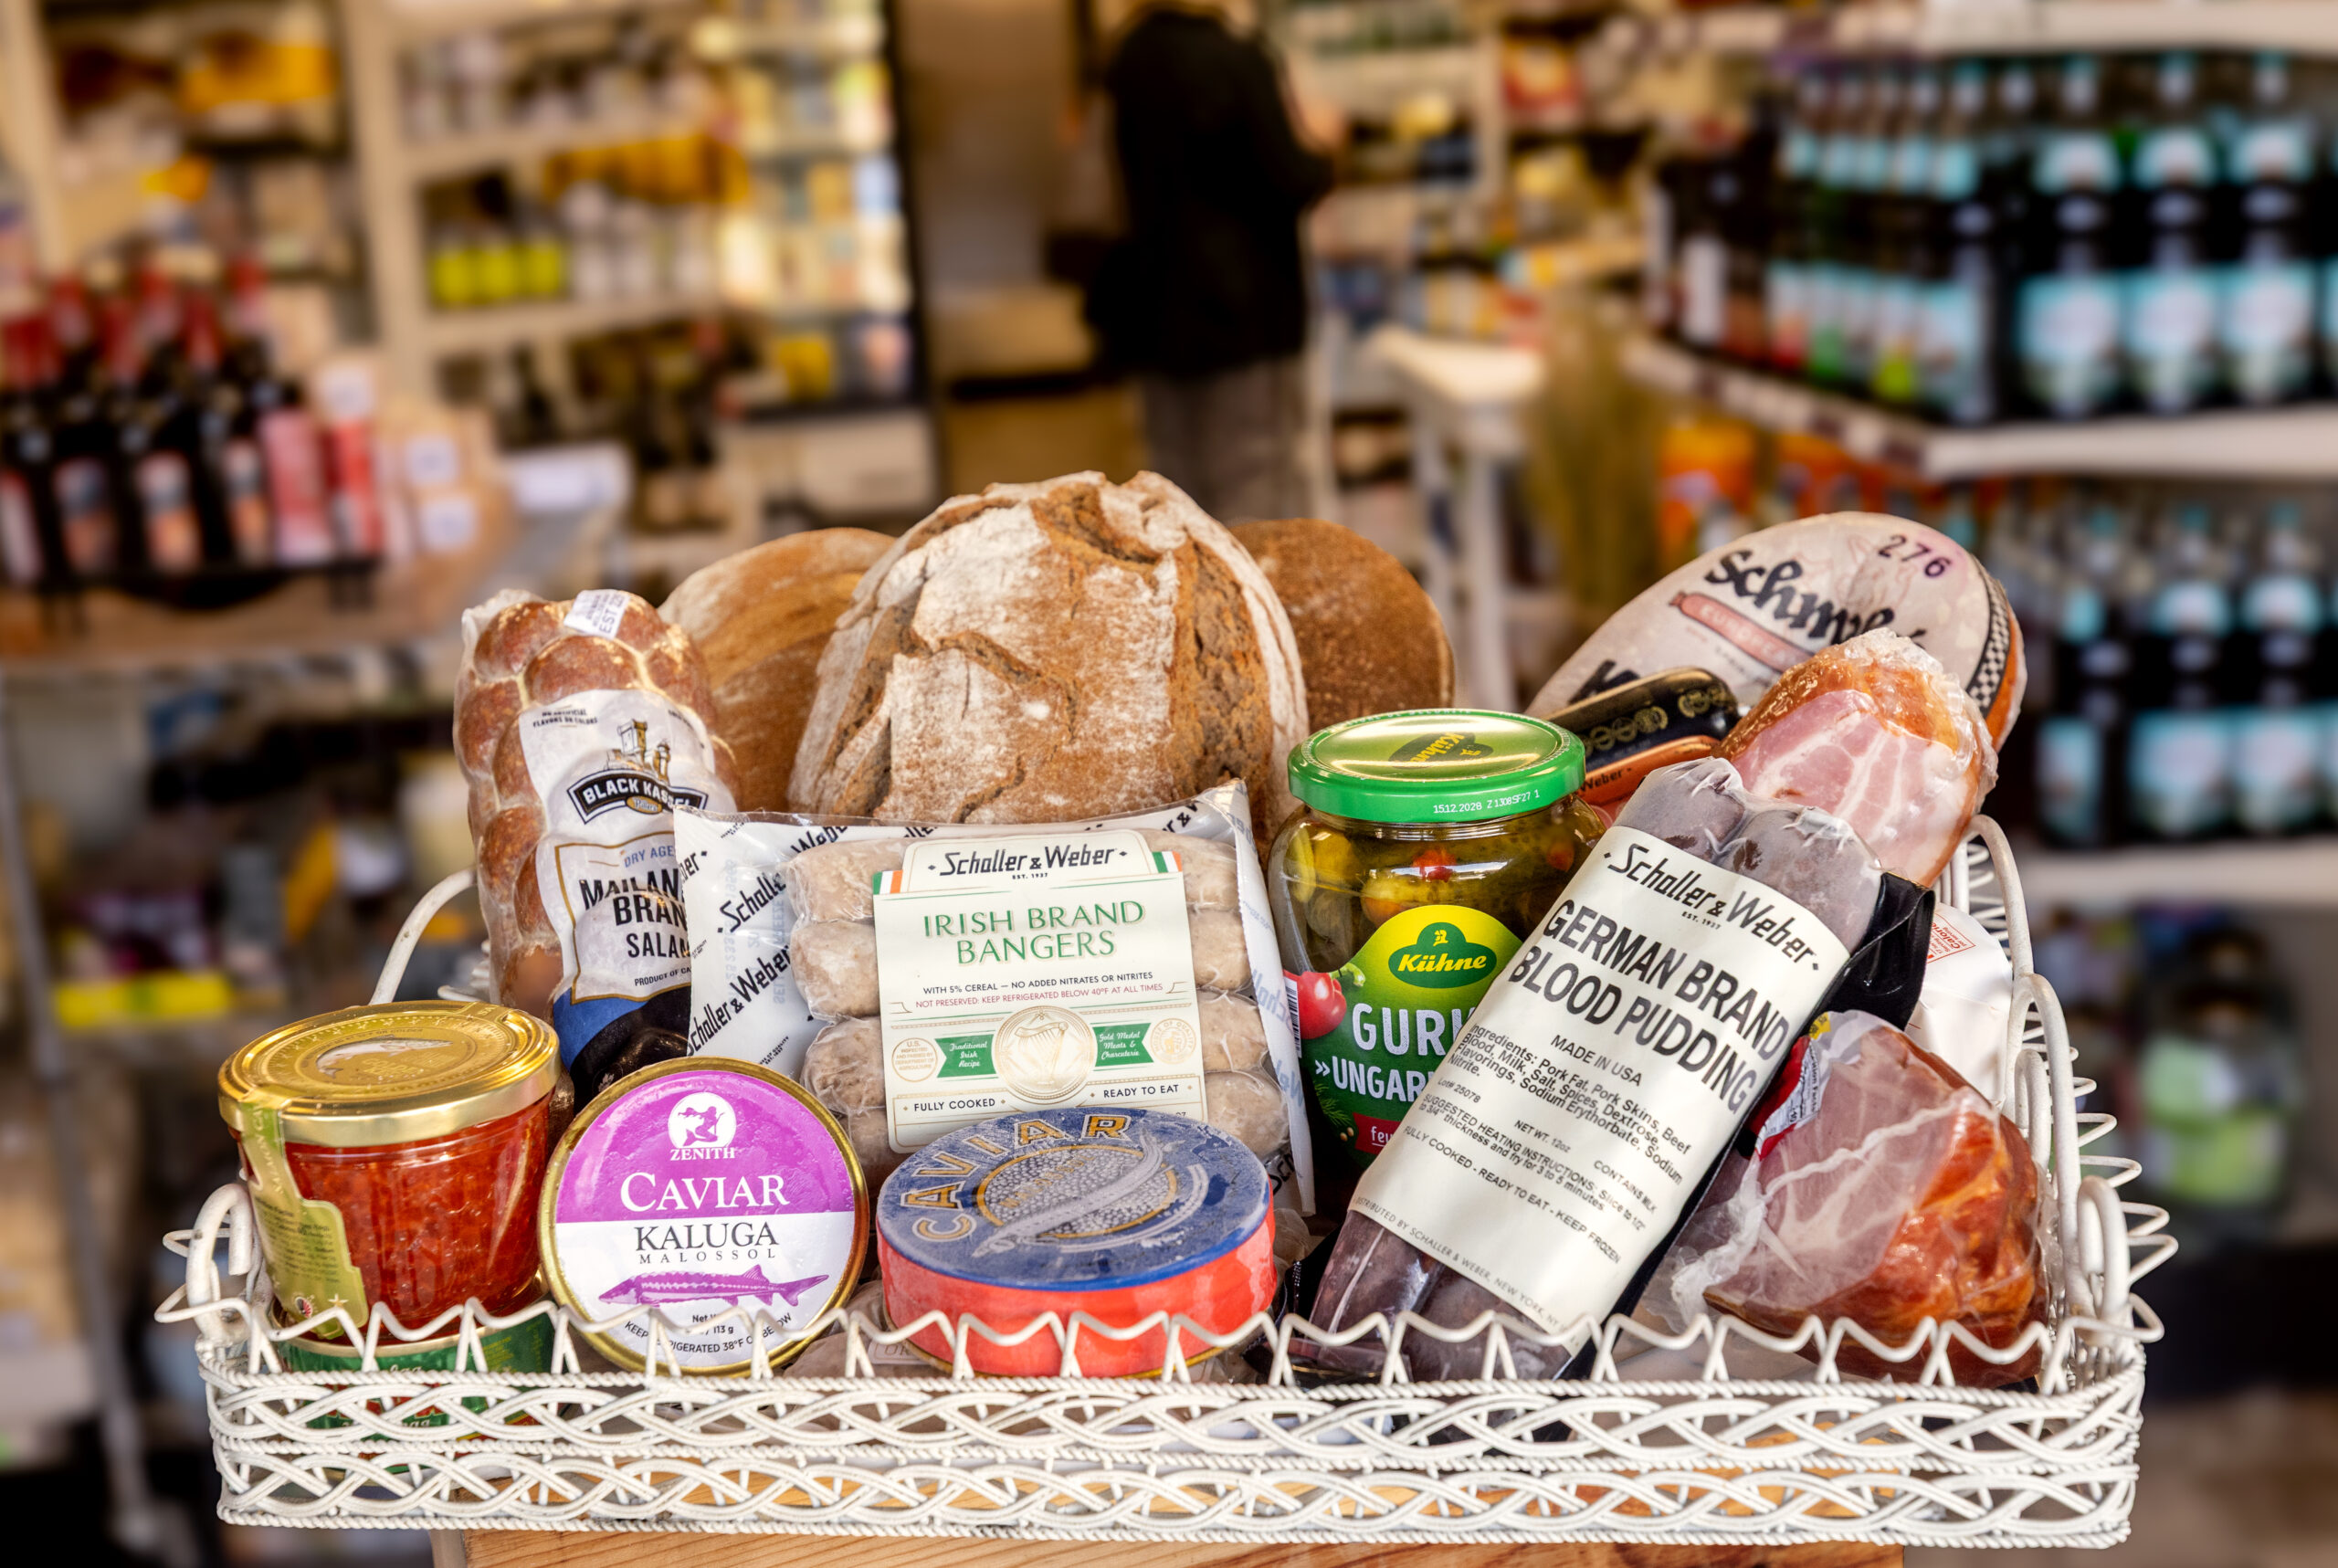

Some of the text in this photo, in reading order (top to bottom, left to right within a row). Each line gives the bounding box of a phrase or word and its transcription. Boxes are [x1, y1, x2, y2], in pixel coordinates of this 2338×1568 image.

[1879, 534, 1952, 577] 276
[583, 778, 638, 805] BLACK
[624, 846, 675, 868] DRY AGE
[940, 844, 1117, 876] Schaller & Weber
[578, 868, 684, 910] MAILAN
[720, 872, 785, 932] Schalle
[1606, 843, 1817, 963] Schaller & Weber
[613, 895, 688, 926] BRAN
[923, 900, 1145, 938] IRISH BRAND
[1681, 910, 1700, 923] EST.
[957, 930, 1116, 965] BANGERS
[1397, 952, 1488, 973] Kühne
[634, 973, 668, 987] PRODUCT
[669, 969, 679, 978] OF
[730, 945, 790, 1003] Weber
[922, 971, 1153, 995] WITH 5% CEREAL NO ADDED NITRATES OR NITRITES
[1543, 899, 1790, 1061] GERMAN BRAND
[731, 998, 744, 1014] &
[916, 1001, 933, 1009] NOT
[935, 997, 979, 1008] PRESERVED:
[982, 995, 1001, 1005] KEEP
[1003, 992, 1059, 1004] REFRIGERATED
[1061, 988, 1089, 998] BELOW
[1111, 986, 1122, 995] AT
[1122, 985, 1138, 994] ALL
[1140, 984, 1164, 994] TIMES
[1099, 1030, 1141, 1044] Gold Medal
[1509, 945, 1622, 1026] BLOOD
[1614, 995, 1757, 1114] PUDDING
[950, 1041, 987, 1052] Traditional
[960, 1051, 978, 1059] Irish
[1104, 1041, 1136, 1051] Meats &
[1551, 1034, 1644, 1088] MADE IN USA
[958, 1060, 981, 1069] Recipe
[1447, 1053, 1481, 1078] Nitrite.
[1103, 1084, 1179, 1099] READY TO EAT
[1454, 1083, 1482, 1104] 25078
[1462, 1032, 1661, 1151] Blood, Milk, Salt, Spices, Dextrose,
[1469, 1023, 1692, 1156] Ingredients: Pork Fat, Pork Skins, Beef
[913, 1099, 996, 1112] FULLY COOKED
[1455, 1042, 1686, 1186] Flavorings, Sodium Erythorbate, Sodium
[1444, 1114, 1489, 1147] thickness
[1490, 1141, 1508, 1158] and
[1508, 1150, 1523, 1167] fry
[1522, 1156, 1537, 1171] for
[1536, 1164, 1543, 1175] 3
[1543, 1169, 1555, 1181] to
[1555, 1174, 1563, 1184] 5
[1514, 1120, 1572, 1154] NET WT. 12oz
[669, 1147, 736, 1162] ZENITH
[1423, 1093, 1478, 1127] SUGGESTED
[1478, 1121, 1522, 1153] HEATING
[1599, 1190, 1624, 1213] Slice
[1623, 1208, 1632, 1219] to
[620, 1172, 790, 1213] CAVIAR
[900, 1113, 1132, 1243] CAVIAR
[1593, 1160, 1643, 1200] CONTAINS
[1404, 1125, 1622, 1265] FULLY COOKED READY TO EAT KEEP FROZEN
[635, 1221, 779, 1252] KALUGA
[1396, 1218, 1409, 1231] BY
[1409, 1226, 1454, 1258] SCHALLER
[1453, 1252, 1459, 1262] &
[1493, 1278, 1520, 1299] NEW
[1547, 1312, 1560, 1326] NY
[625, 1321, 649, 1340] KEEP
[692, 1314, 708, 1323] Net
[713, 1325, 726, 1334] 113
